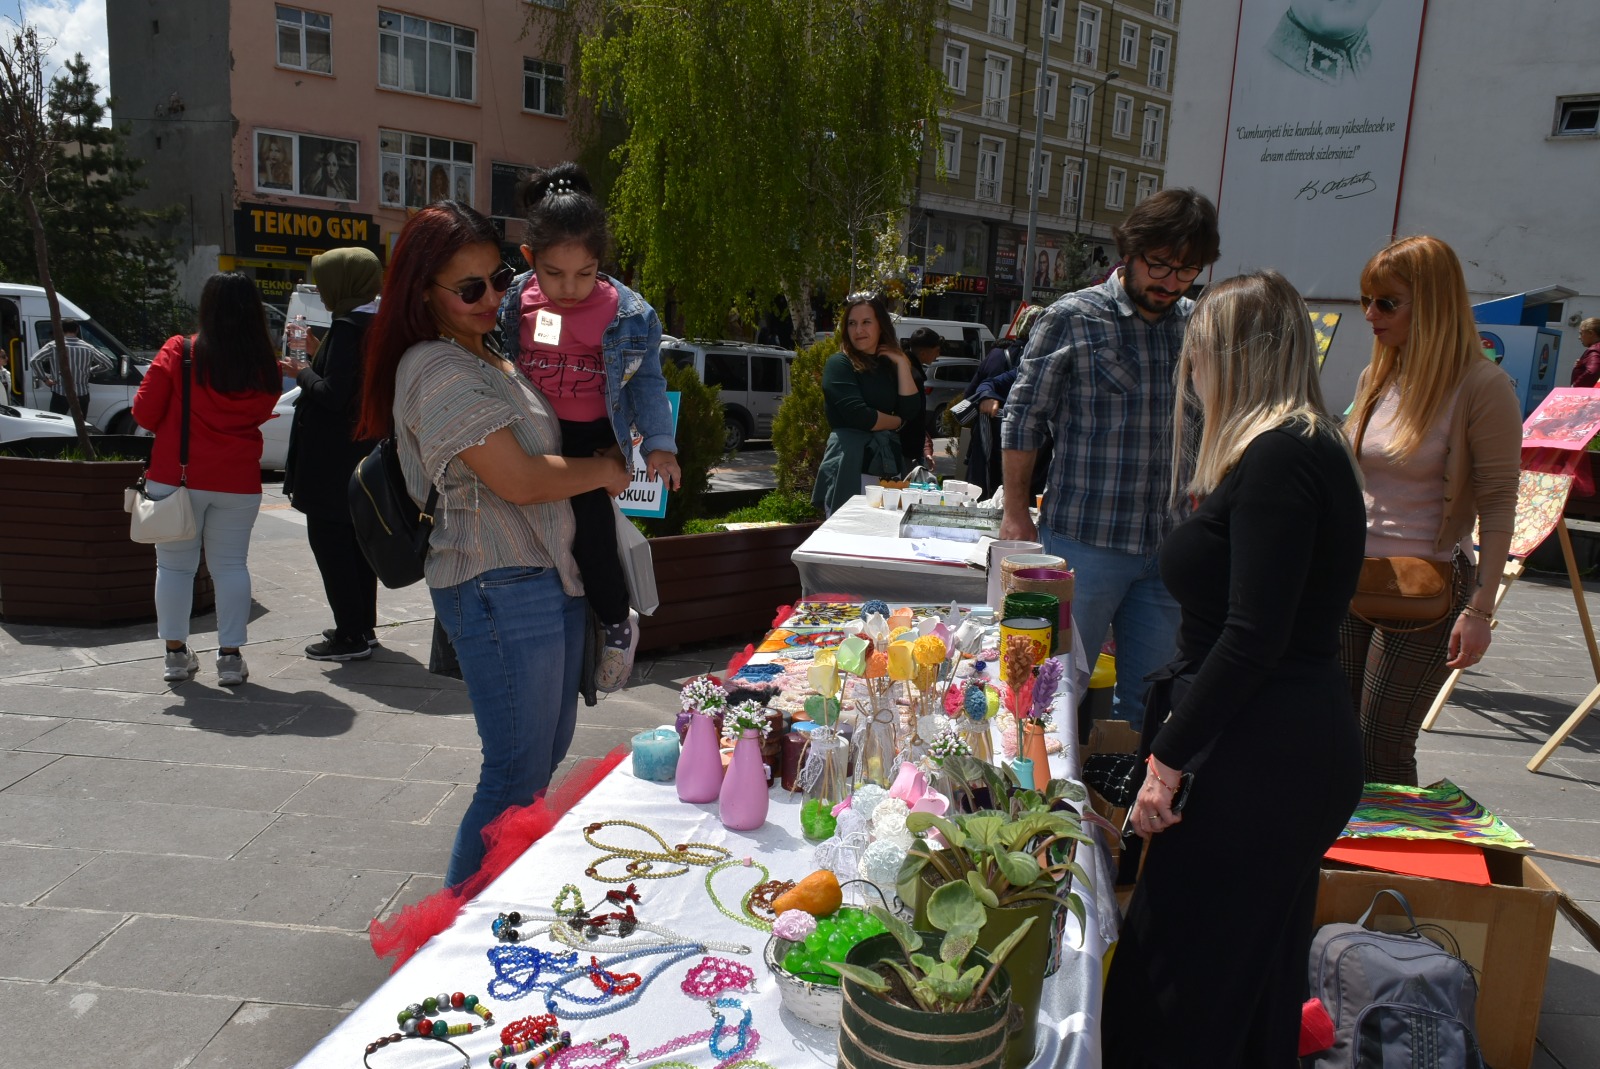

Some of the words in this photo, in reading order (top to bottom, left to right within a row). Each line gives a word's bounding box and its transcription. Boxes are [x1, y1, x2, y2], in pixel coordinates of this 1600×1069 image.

[1282, 122, 1294, 138] biz
[1294, 120, 1324, 137] kurduk,
[1325, 125, 1340, 135] onu
[1340, 117, 1385, 139] yükseltecek
[1386, 122, 1396, 131] ve
[1260, 148, 1284, 162] devam
[1285, 146, 1315, 161] ettirecek
[250, 210, 322, 237] TEKNO
[327, 217, 367, 240] GSM
[254, 279, 293, 290] TEKNO
[263, 288, 283, 297] GSM
[618, 488, 655, 503] OKULU
